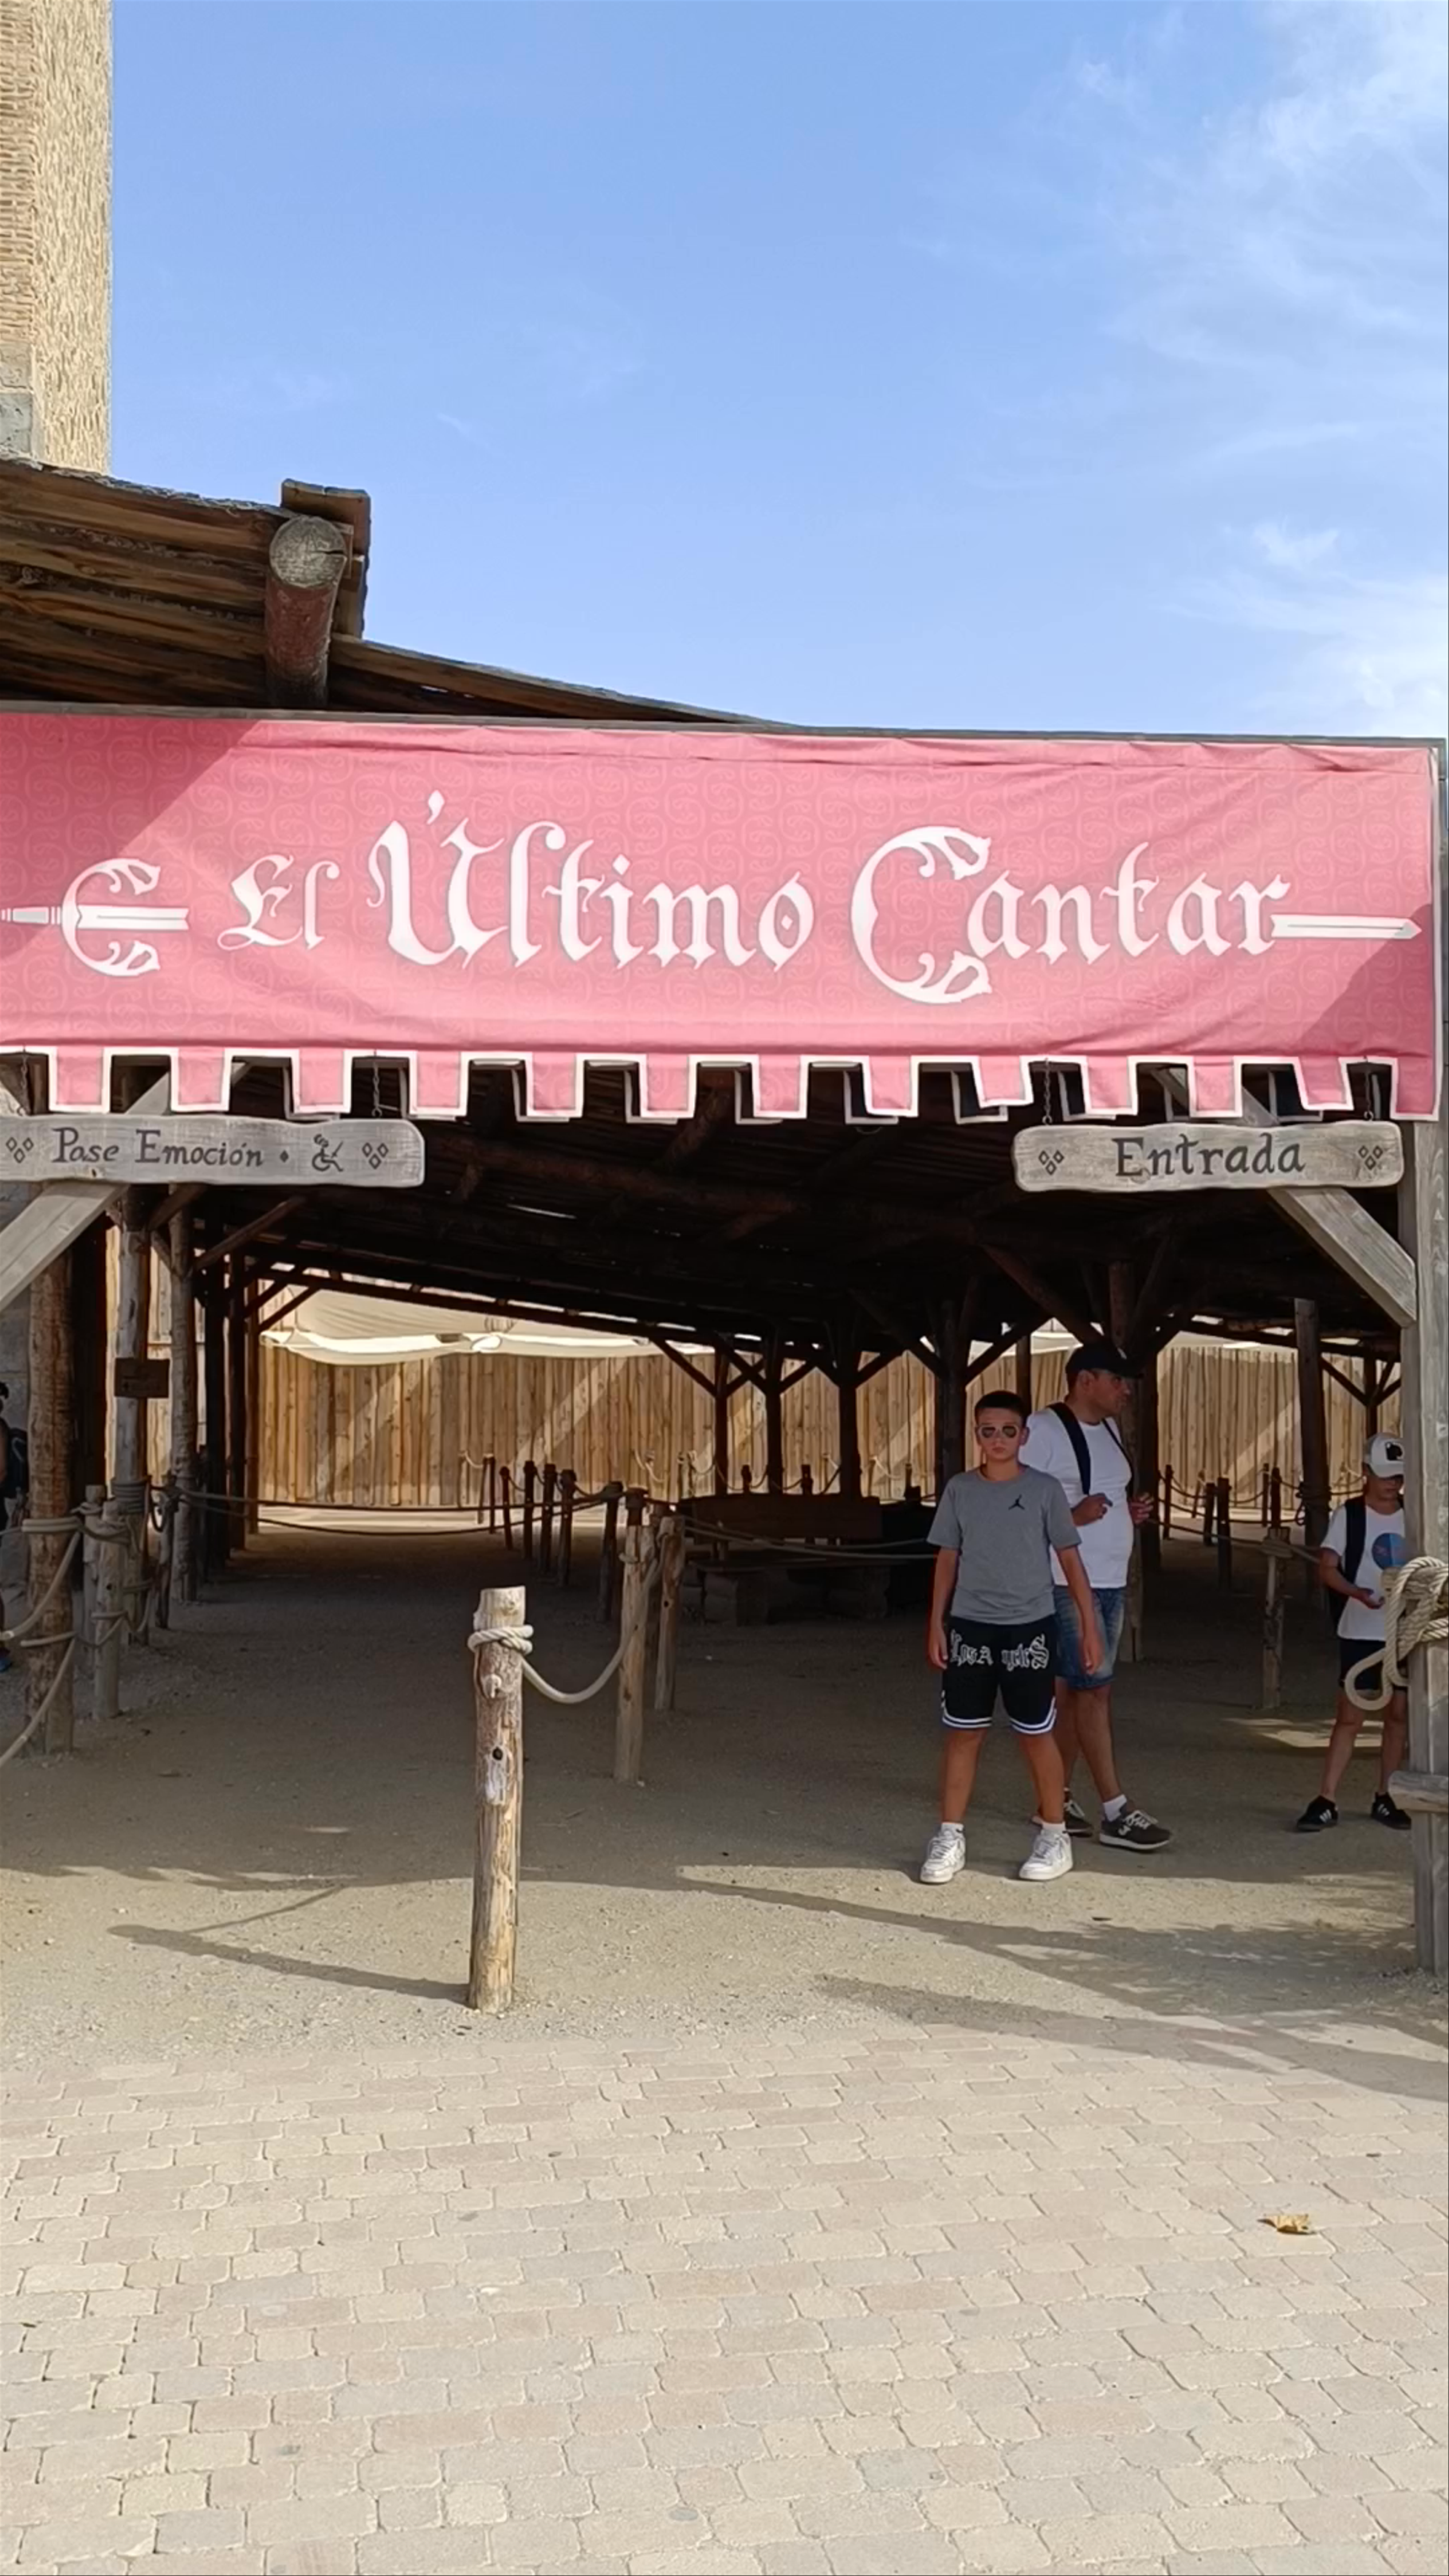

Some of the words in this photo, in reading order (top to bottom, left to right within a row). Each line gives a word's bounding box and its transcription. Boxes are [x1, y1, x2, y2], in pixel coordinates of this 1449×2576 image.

[217, 854, 340, 950] El
[366, 790, 814, 972] Último
[851, 826, 1291, 1004] Cantar
[52, 1126, 120, 1163] Pase
[134, 1129, 264, 1168] Emoción
[1111, 1132, 1306, 1177] Entrada
